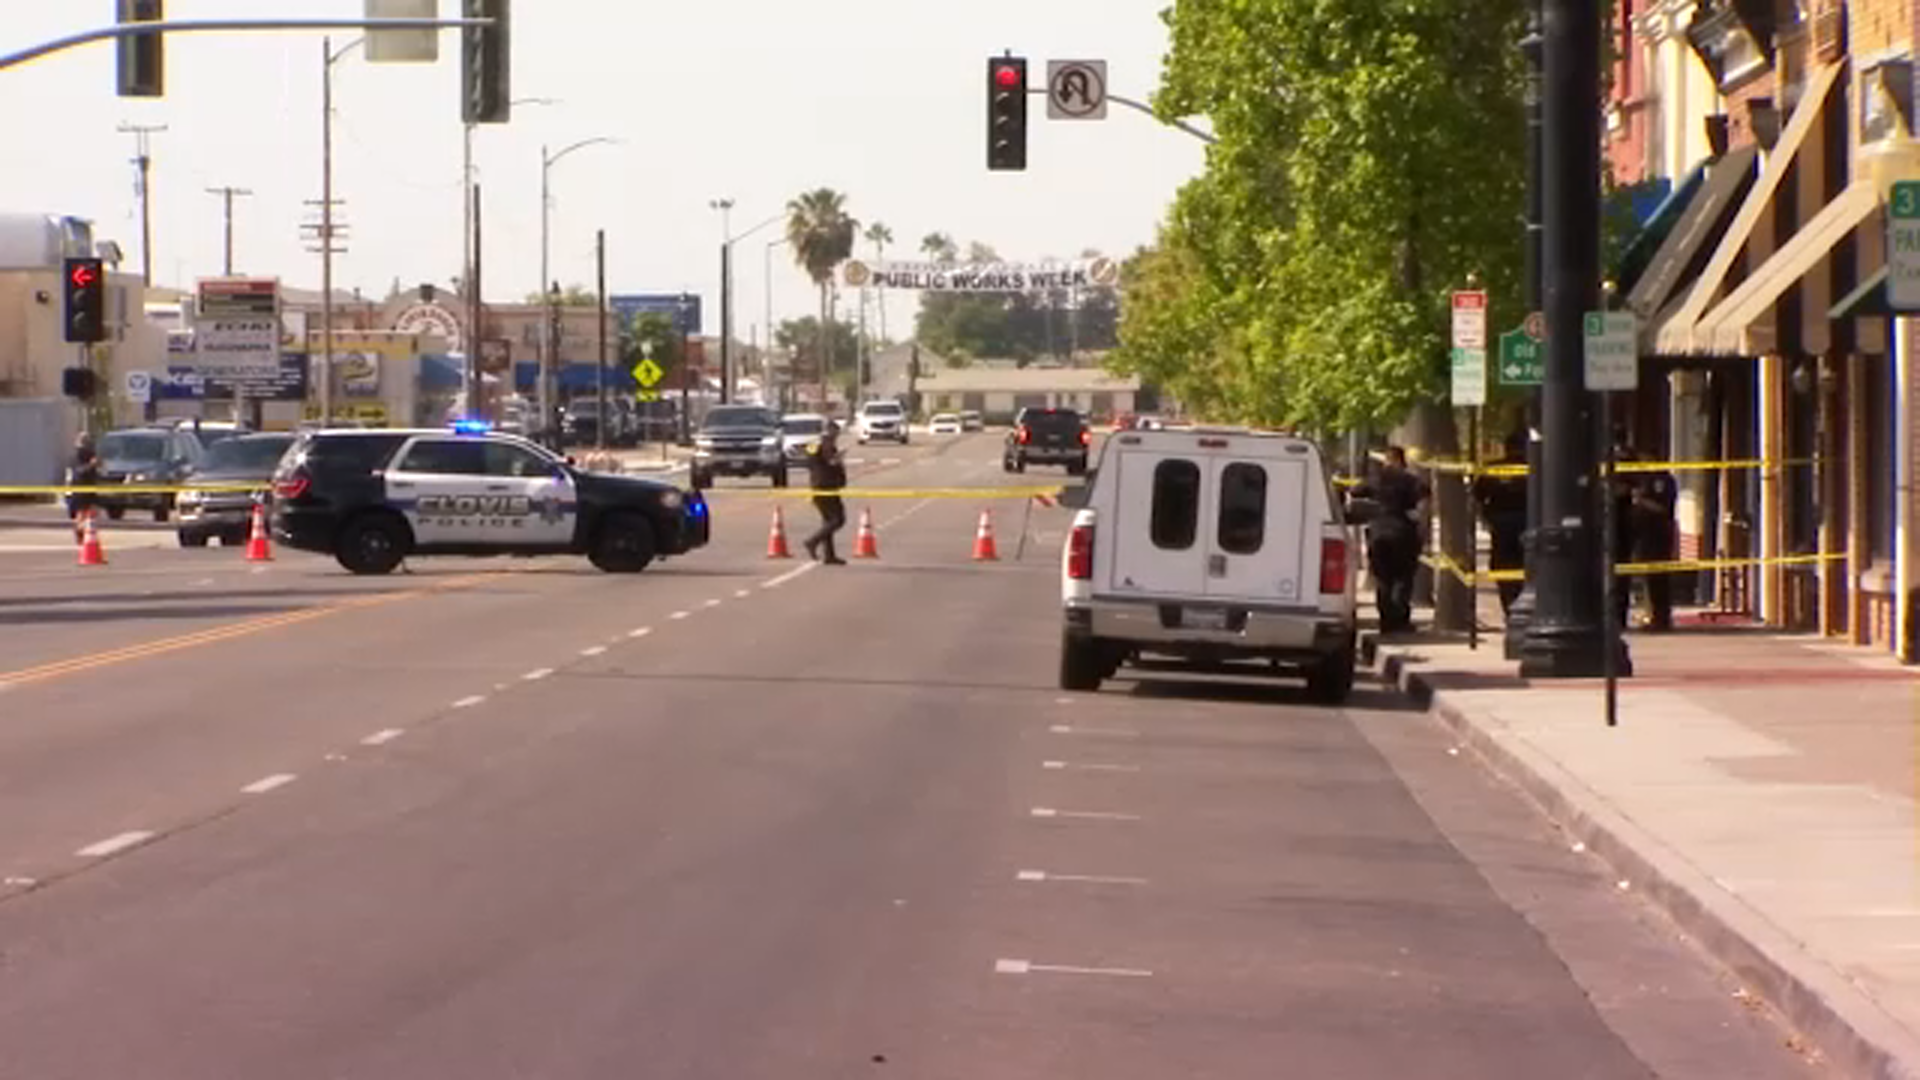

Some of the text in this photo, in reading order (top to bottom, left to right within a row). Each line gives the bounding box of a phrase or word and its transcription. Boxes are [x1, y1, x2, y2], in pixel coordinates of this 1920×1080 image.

[1895, 188, 1915, 215] 3
[872, 269, 1087, 290] PUBLIC WORKS WEEK
[418, 496, 531, 516] CLOVIS
[418, 518, 526, 528] POLICE
